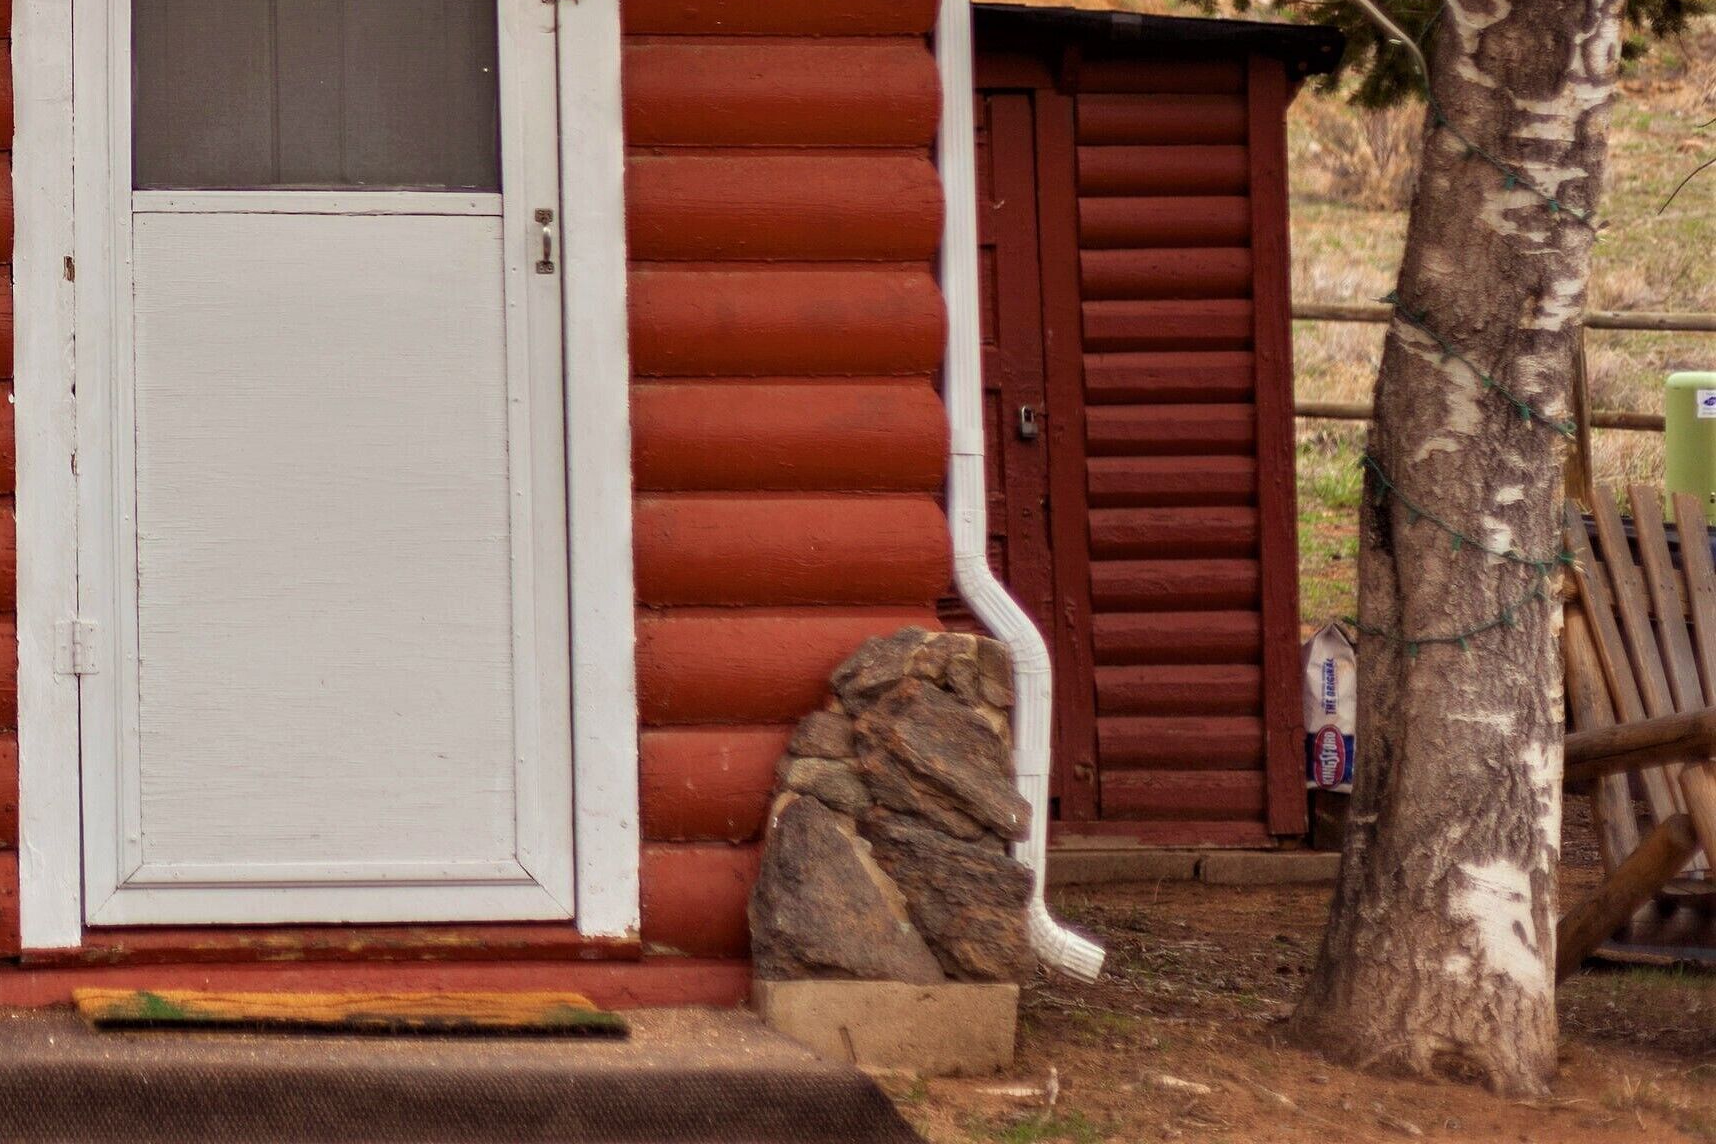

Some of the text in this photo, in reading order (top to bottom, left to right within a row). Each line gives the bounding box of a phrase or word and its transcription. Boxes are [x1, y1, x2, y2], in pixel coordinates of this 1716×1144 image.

[1325, 658, 1336, 715] THE ORIGINAL
[1319, 731, 1340, 785] KINGSFORD
